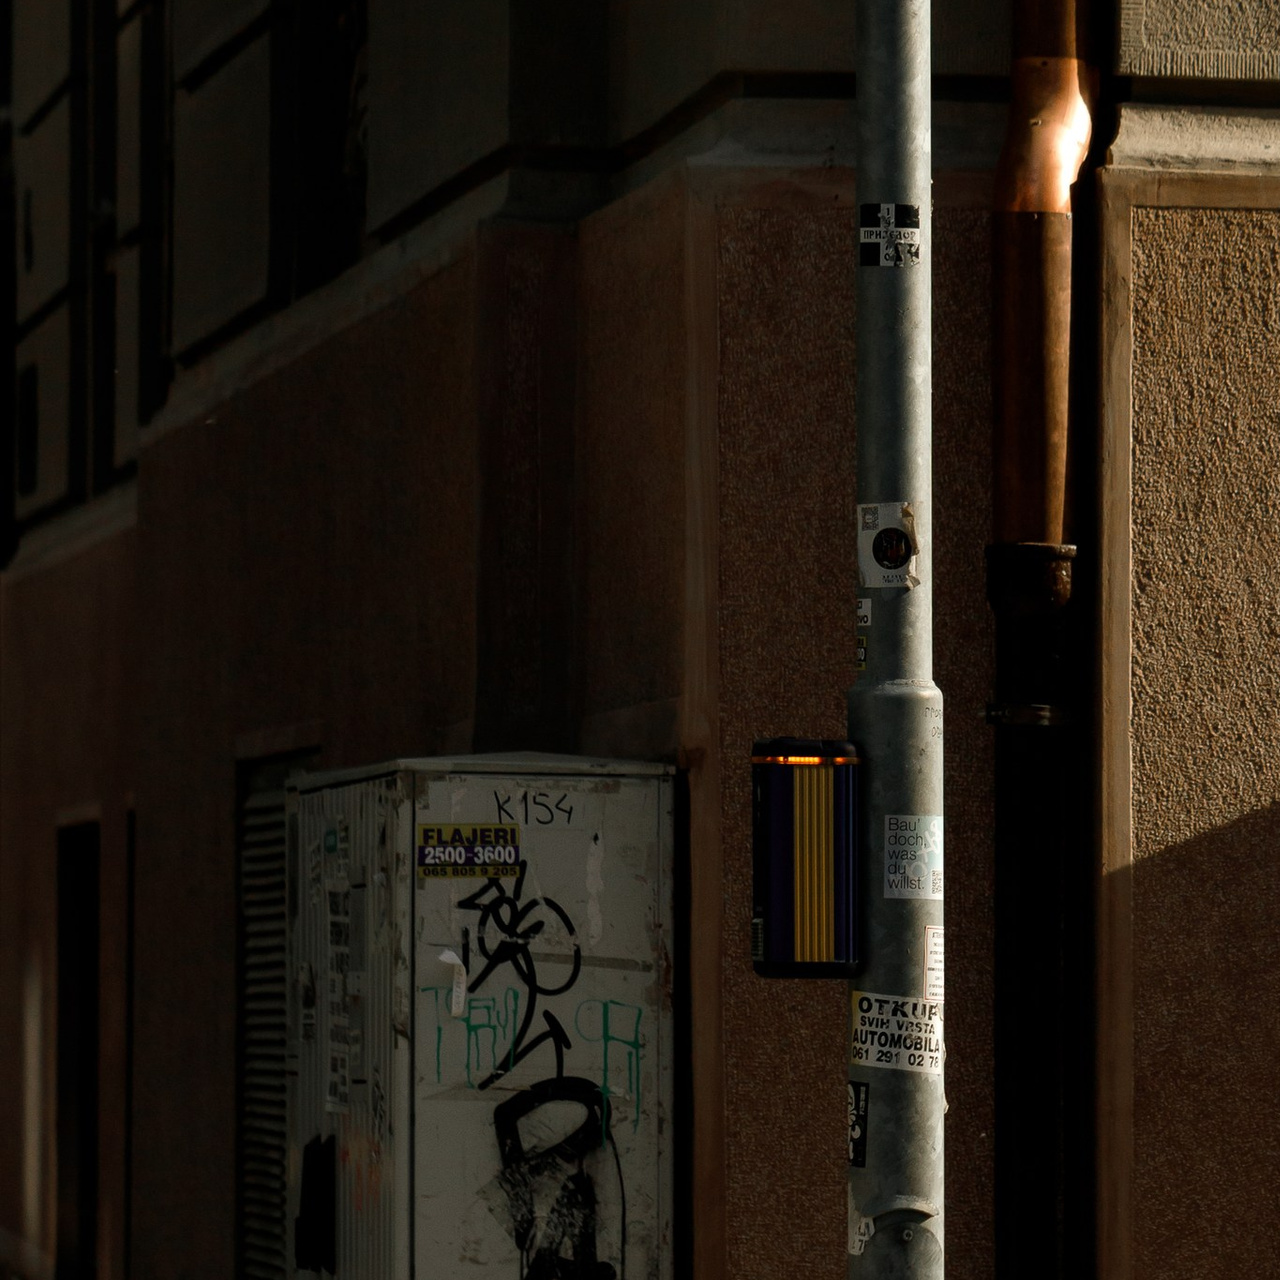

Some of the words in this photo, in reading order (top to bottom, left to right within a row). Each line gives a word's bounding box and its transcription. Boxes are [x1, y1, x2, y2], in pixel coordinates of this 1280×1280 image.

[888, 817, 921, 832] Bau'
[423, 828, 516, 846] FLAJERI
[888, 831, 927, 849] doch,
[424, 846, 516, 865] 2500-3600
[887, 849, 917, 861] was
[423, 866, 447, 877] 065
[452, 866, 476, 877] 805
[480, 866, 489, 877] 9
[493, 866, 517, 877] 205
[887, 861, 906, 875] du
[887, 875, 925, 890] willst.
[860, 1015, 890, 1030] SVIH
[896, 1019, 935, 1035] VRSTA
[852, 1027, 940, 1054] AUTOMOBILA
[852, 1045, 870, 1061] 061
[876, 1049, 901, 1066] 291
[908, 1053, 925, 1067] 02
